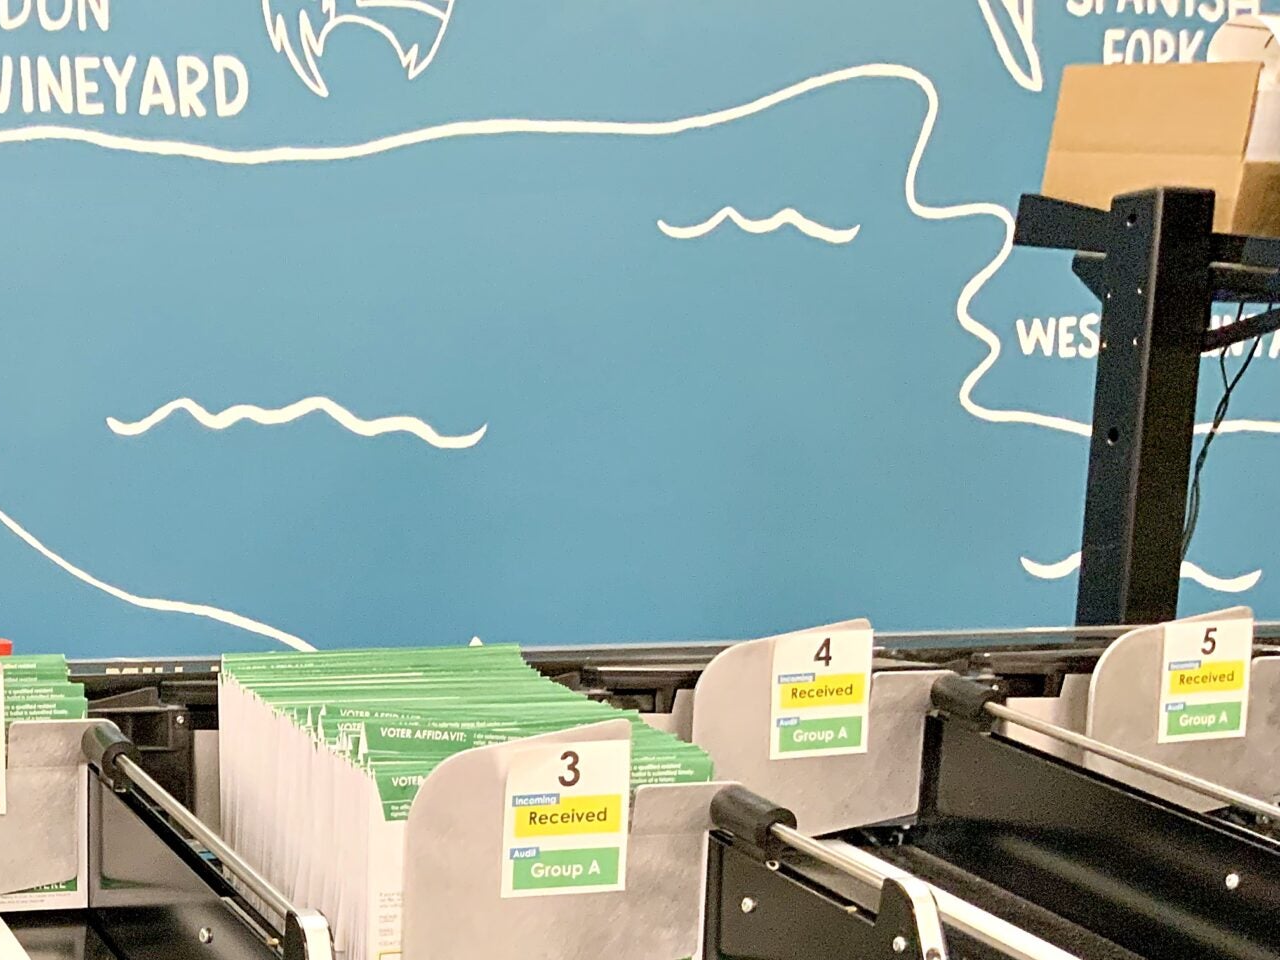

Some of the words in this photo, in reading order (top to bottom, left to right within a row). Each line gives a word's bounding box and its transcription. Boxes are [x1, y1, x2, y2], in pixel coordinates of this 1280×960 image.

[1201, 627, 1217, 655] 5
[813, 637, 832, 667] 4
[1179, 670, 1235, 686] Received
[791, 684, 854, 700] Received
[1179, 713, 1216, 727] Group
[1218, 710, 1228, 723] A
[380, 726, 412, 738] VOTER
[414, 728, 467, 743] AFFIDAVIT:
[793, 729, 834, 743] Group
[837, 726, 848, 739] A
[558, 750, 581, 787] 3
[515, 794, 557, 805] Incoming
[528, 807, 608, 826] Received
[530, 862, 583, 879] Group
[588, 860, 601, 875] A
